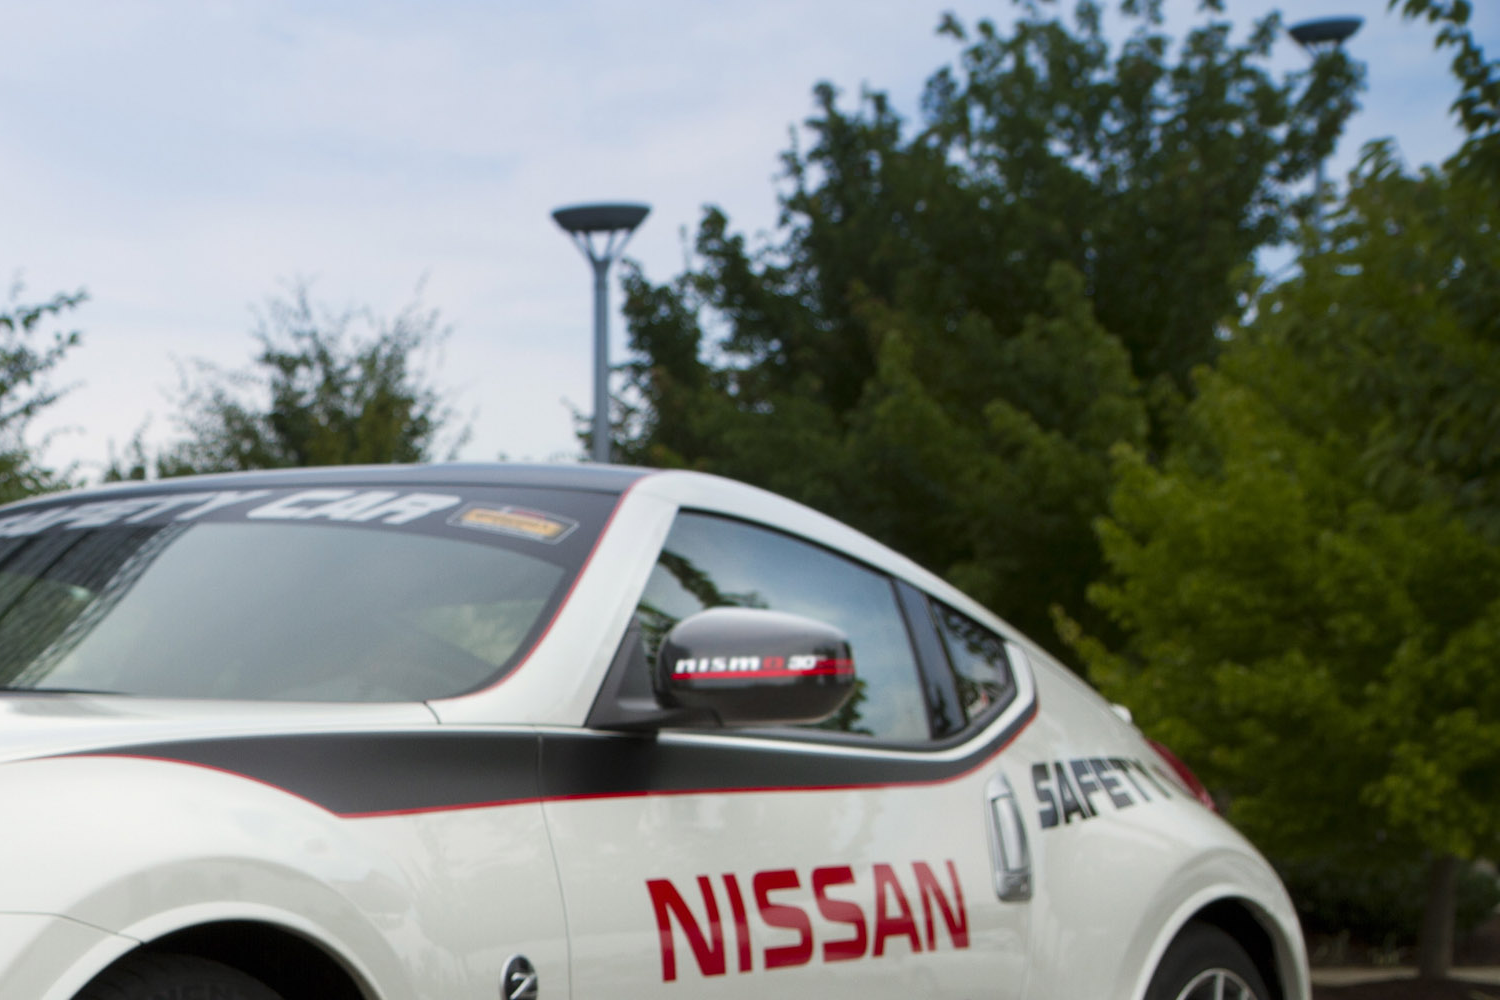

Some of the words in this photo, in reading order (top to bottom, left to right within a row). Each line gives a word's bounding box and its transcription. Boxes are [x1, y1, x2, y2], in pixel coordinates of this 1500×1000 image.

[246, 490, 461, 526] CAR
[674, 655, 785, 674] nismo
[645, 859, 971, 983] NISSAN
